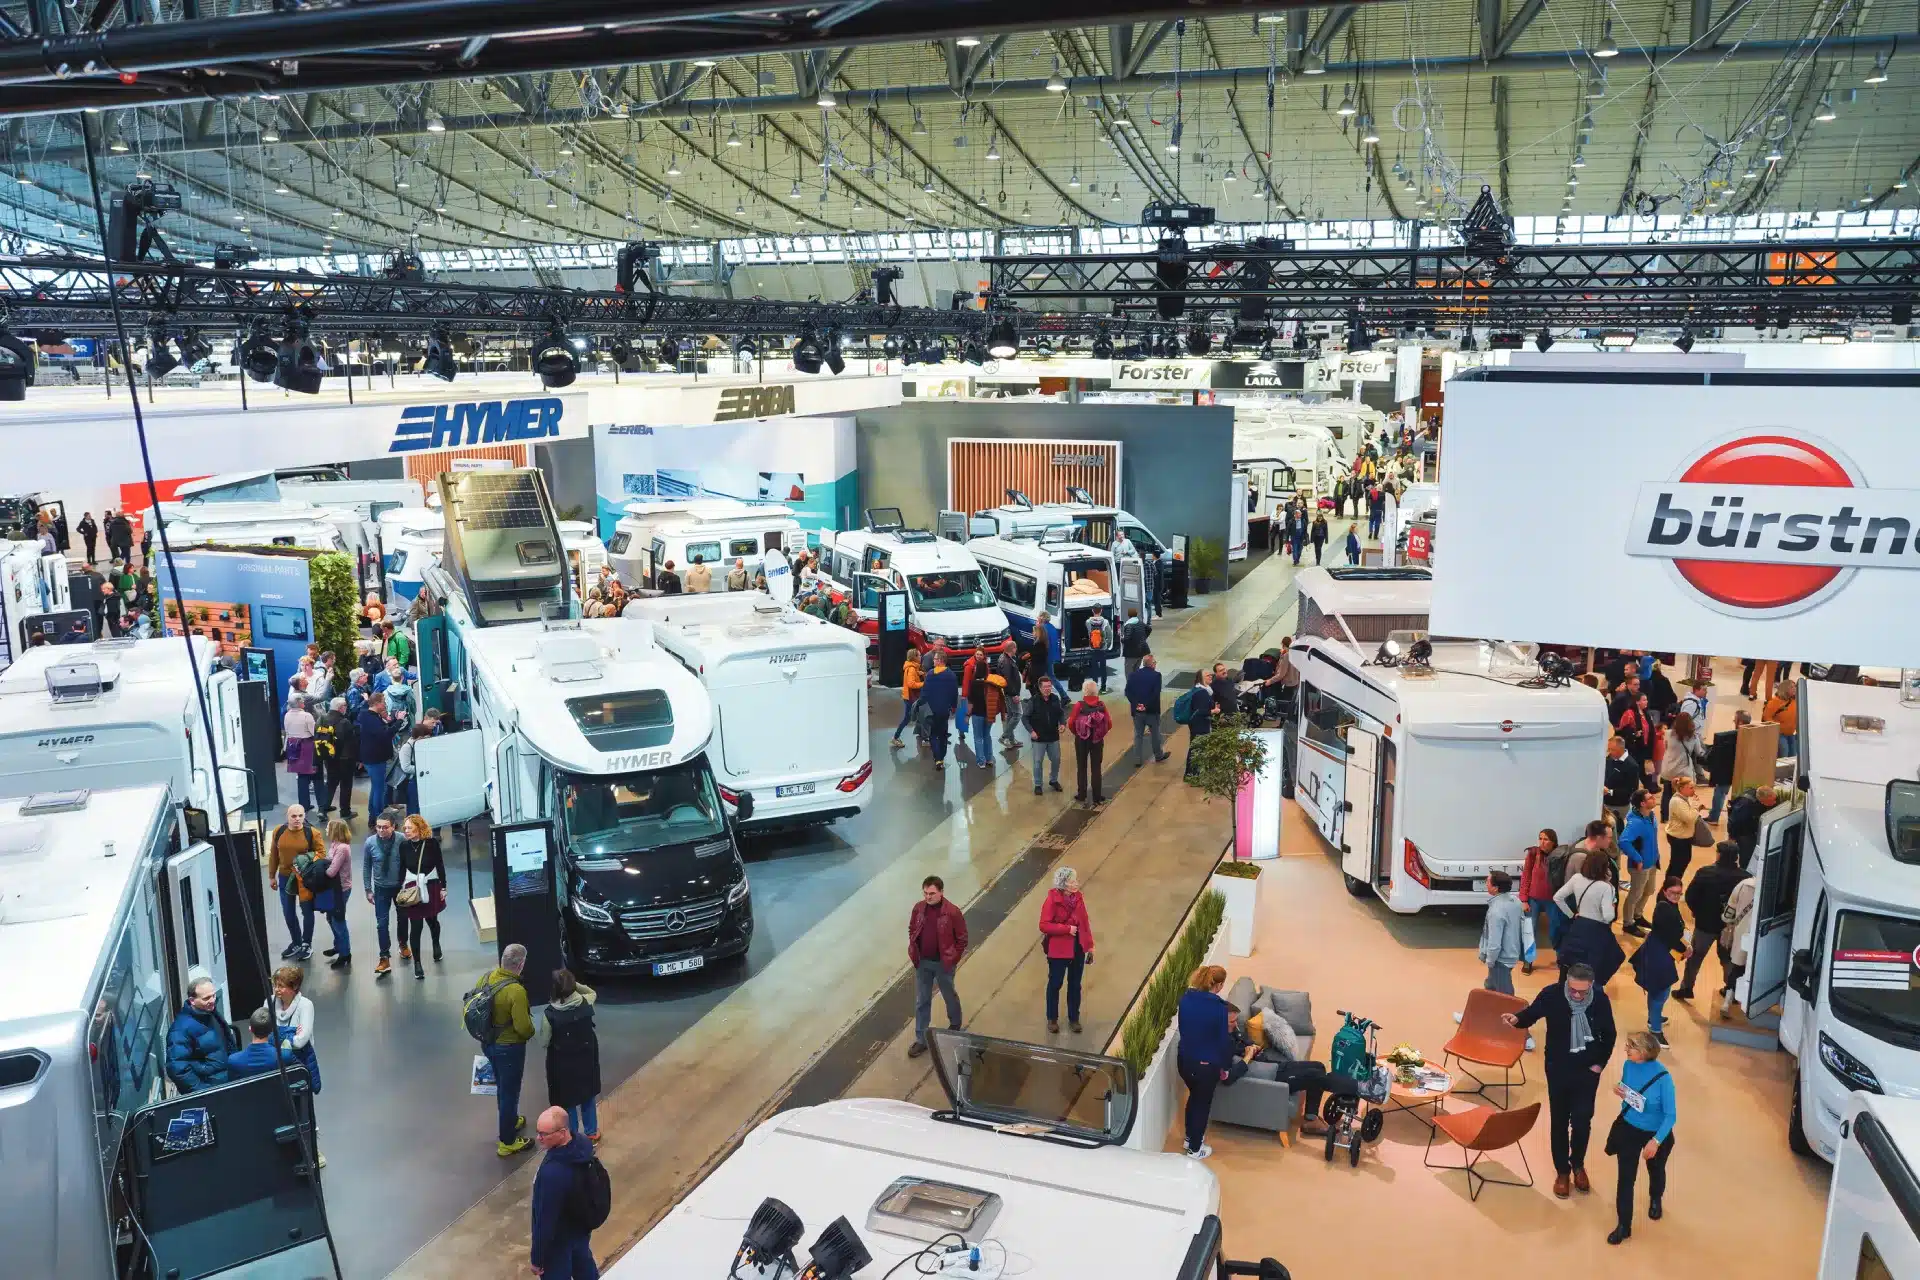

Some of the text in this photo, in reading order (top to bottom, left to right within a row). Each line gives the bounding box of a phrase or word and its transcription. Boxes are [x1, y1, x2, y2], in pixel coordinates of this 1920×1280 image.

[1118, 364, 1194, 380] Forster
[1339, 361, 1382, 374] rster
[1244, 377, 1283, 387] LAIKA
[736, 384, 796, 419] ERIBA
[428, 397, 564, 449] HYMER
[618, 424, 654, 436] ERIBA
[1062, 454, 1105, 467] ERIBA
[237, 563, 301, 577] ORIGINAL PARTS
[769, 652, 808, 664] HYMER
[38, 735, 95, 747] HYMER
[606, 751, 672, 771] HYMER
[1443, 864, 1524, 874] BÜRSTN
[658, 965, 664, 973] B
[680, 961, 685, 969] T
